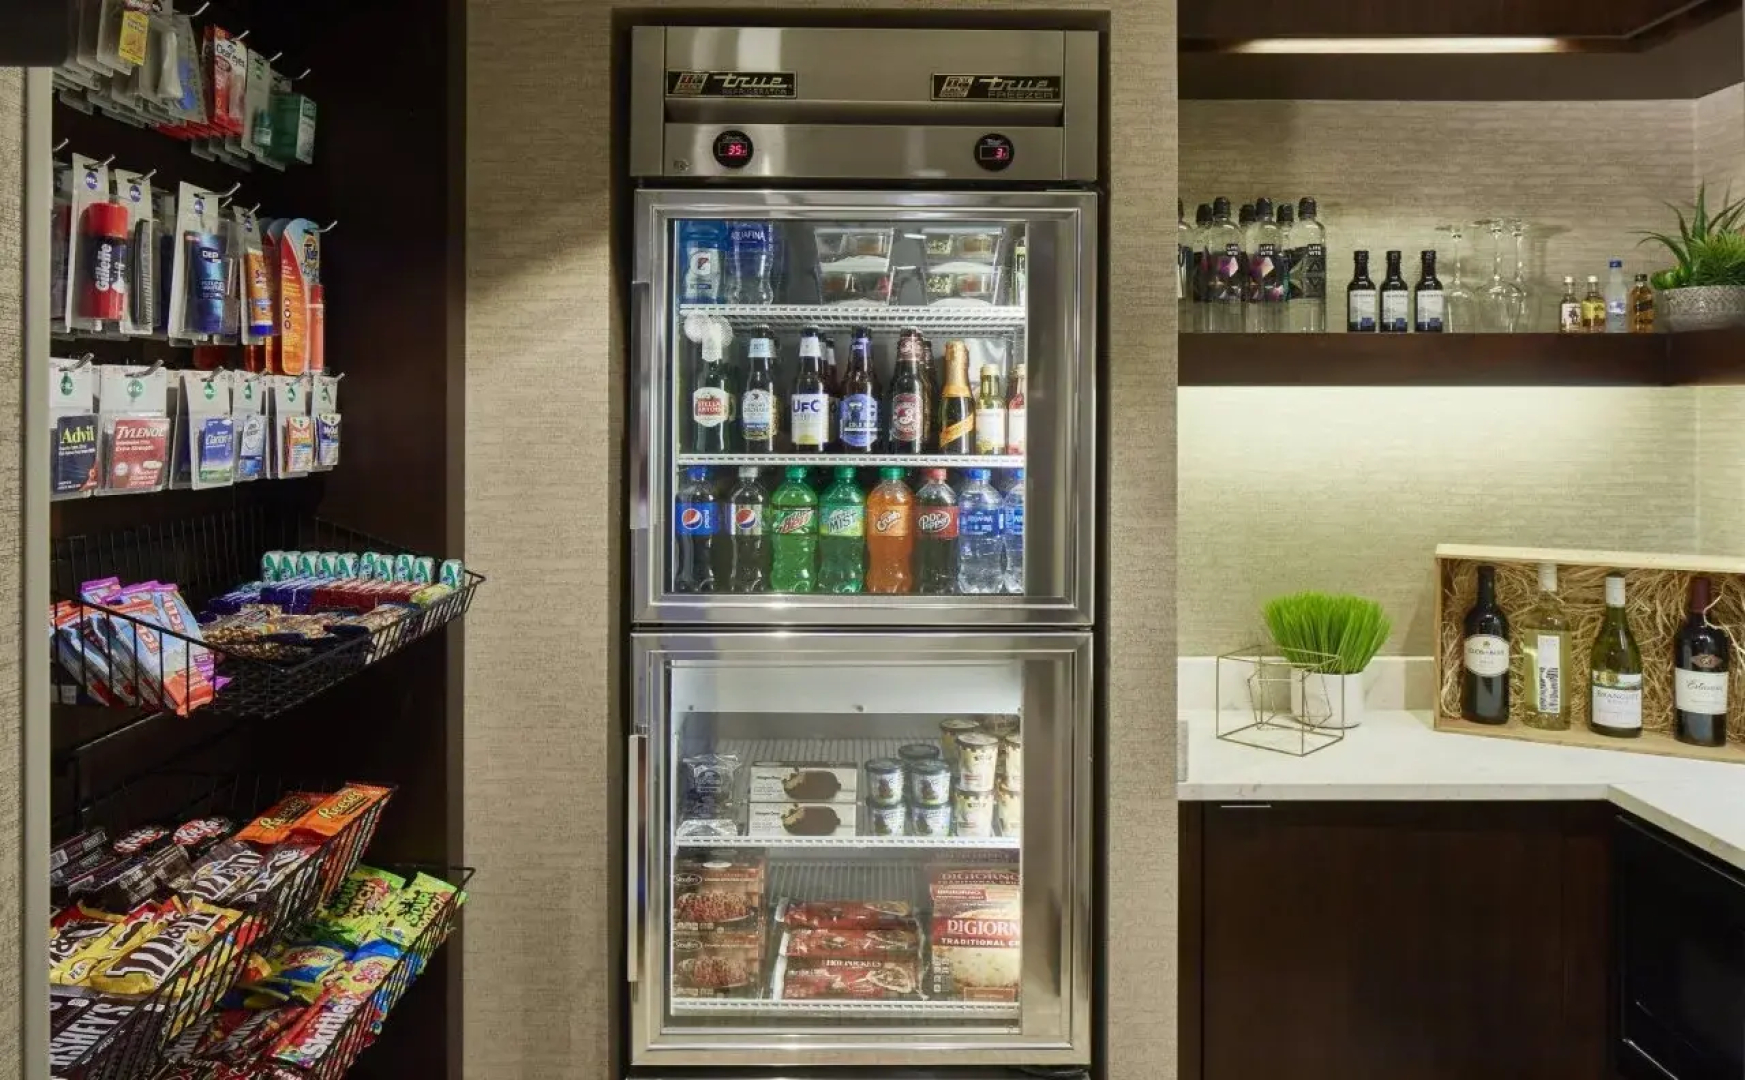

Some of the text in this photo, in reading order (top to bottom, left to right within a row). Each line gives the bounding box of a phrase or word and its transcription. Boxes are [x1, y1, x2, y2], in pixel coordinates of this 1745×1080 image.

[216, 43, 245, 68] Clear eyes
[713, 74, 788, 88] true
[980, 76, 1058, 91] true
[987, 91, 1054, 99] FREEZER
[95, 243, 112, 292] Gillette
[62, 425, 95, 443] Advil
[116, 426, 165, 440] TYLENOL
[876, 511, 901, 531] Crush
[404, 890, 432, 927] SOUR
[941, 937, 1005, 946] TRADITIONAL
